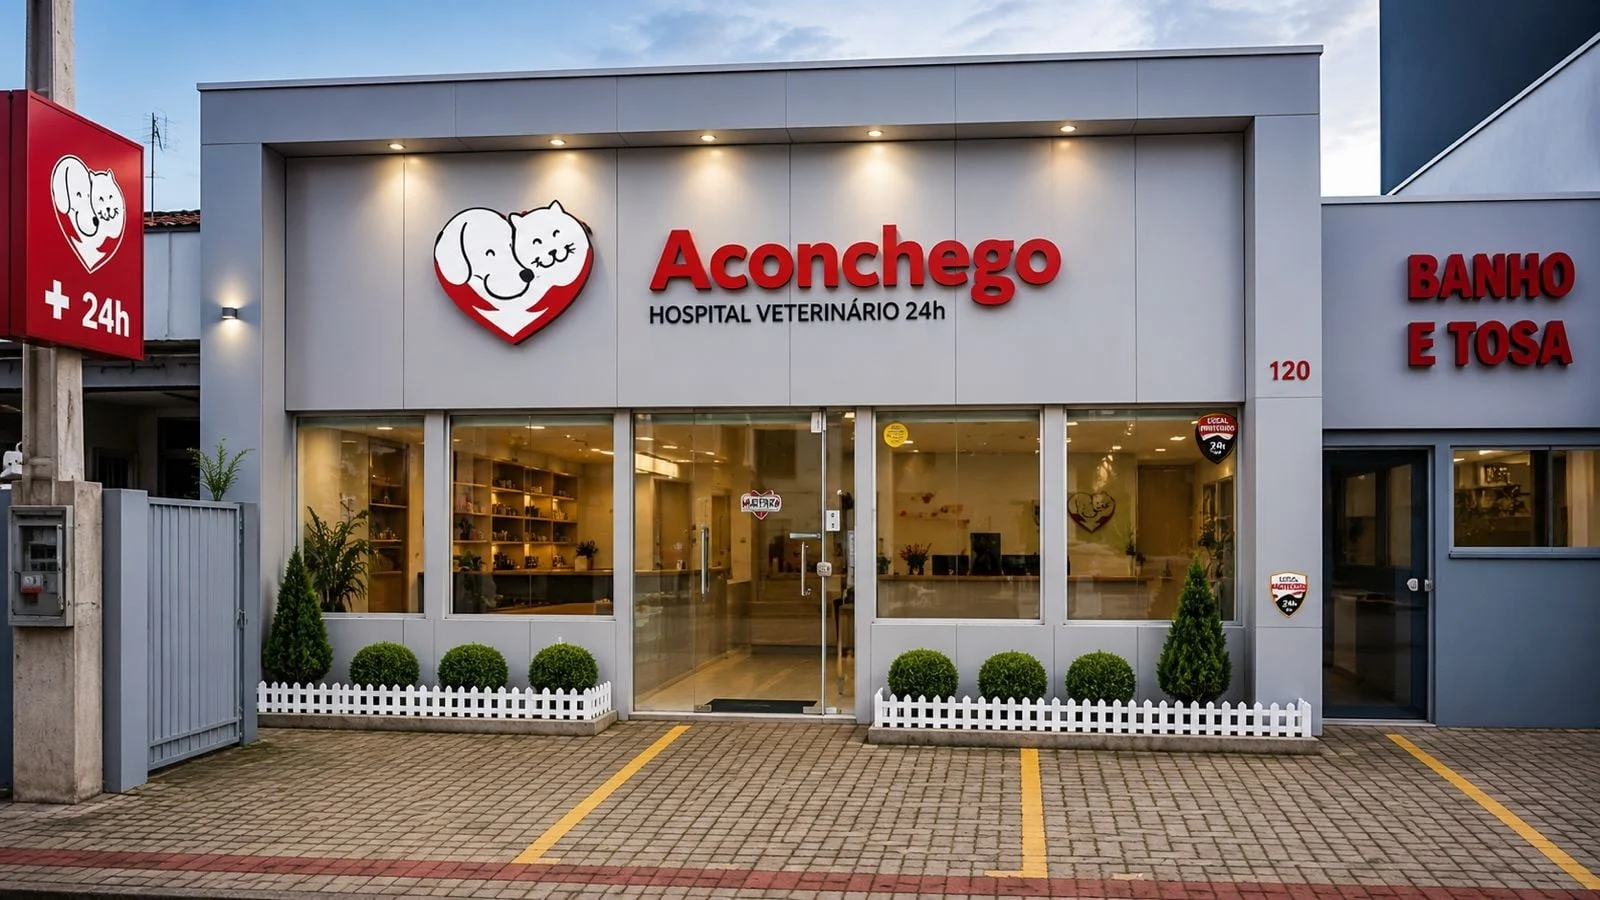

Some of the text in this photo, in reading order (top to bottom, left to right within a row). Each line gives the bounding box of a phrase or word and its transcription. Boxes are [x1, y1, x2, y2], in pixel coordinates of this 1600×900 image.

[650, 225, 1061, 306] Aconchego
[1407, 252, 1575, 300] BANHO
[83, 291, 130, 337] 24h
[649, 299, 946, 324] HOSPITAL VETERINÁRIO 24h
[1408, 320, 1573, 367] E TOSA
[1269, 360, 1311, 381] 120
